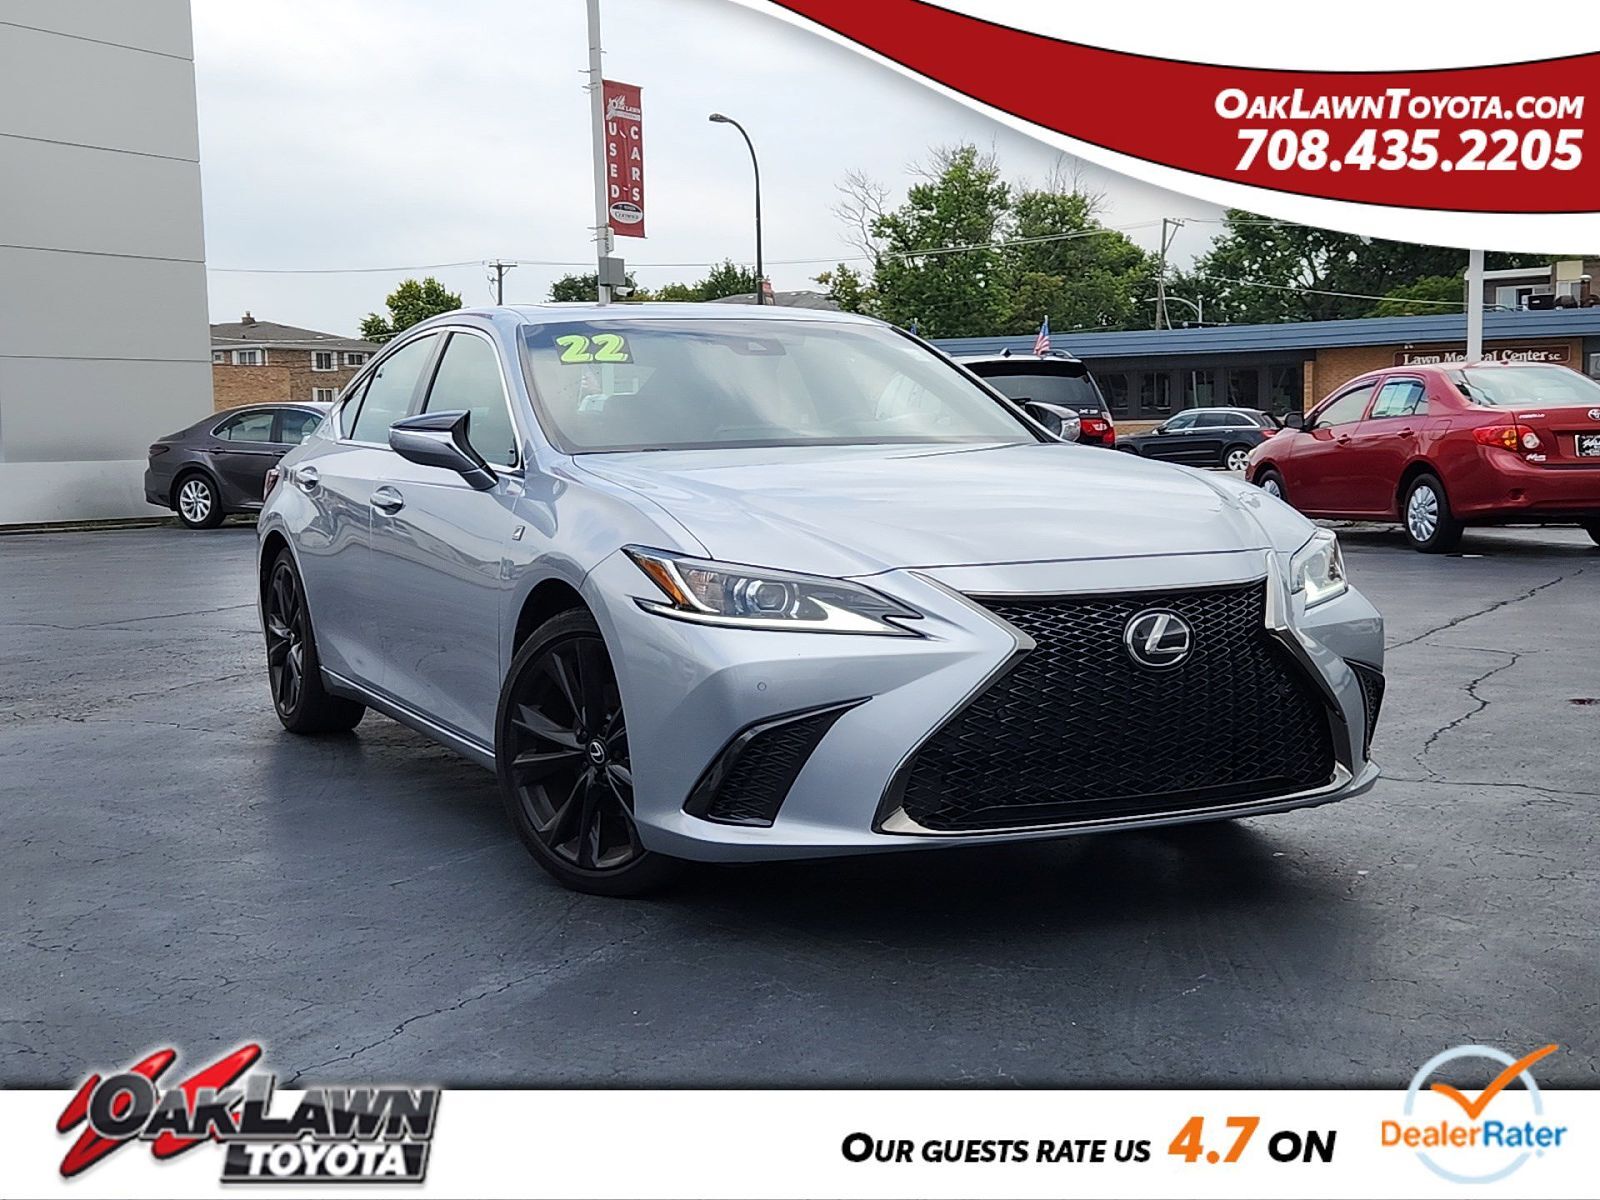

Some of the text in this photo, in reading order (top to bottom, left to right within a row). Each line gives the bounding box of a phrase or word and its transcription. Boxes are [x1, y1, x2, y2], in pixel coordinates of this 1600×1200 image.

[555, 333, 629, 363] 22
[1403, 353, 1440, 365] Lawn
[1444, 350, 1498, 362] Meal
[1501, 349, 1549, 362] Center
